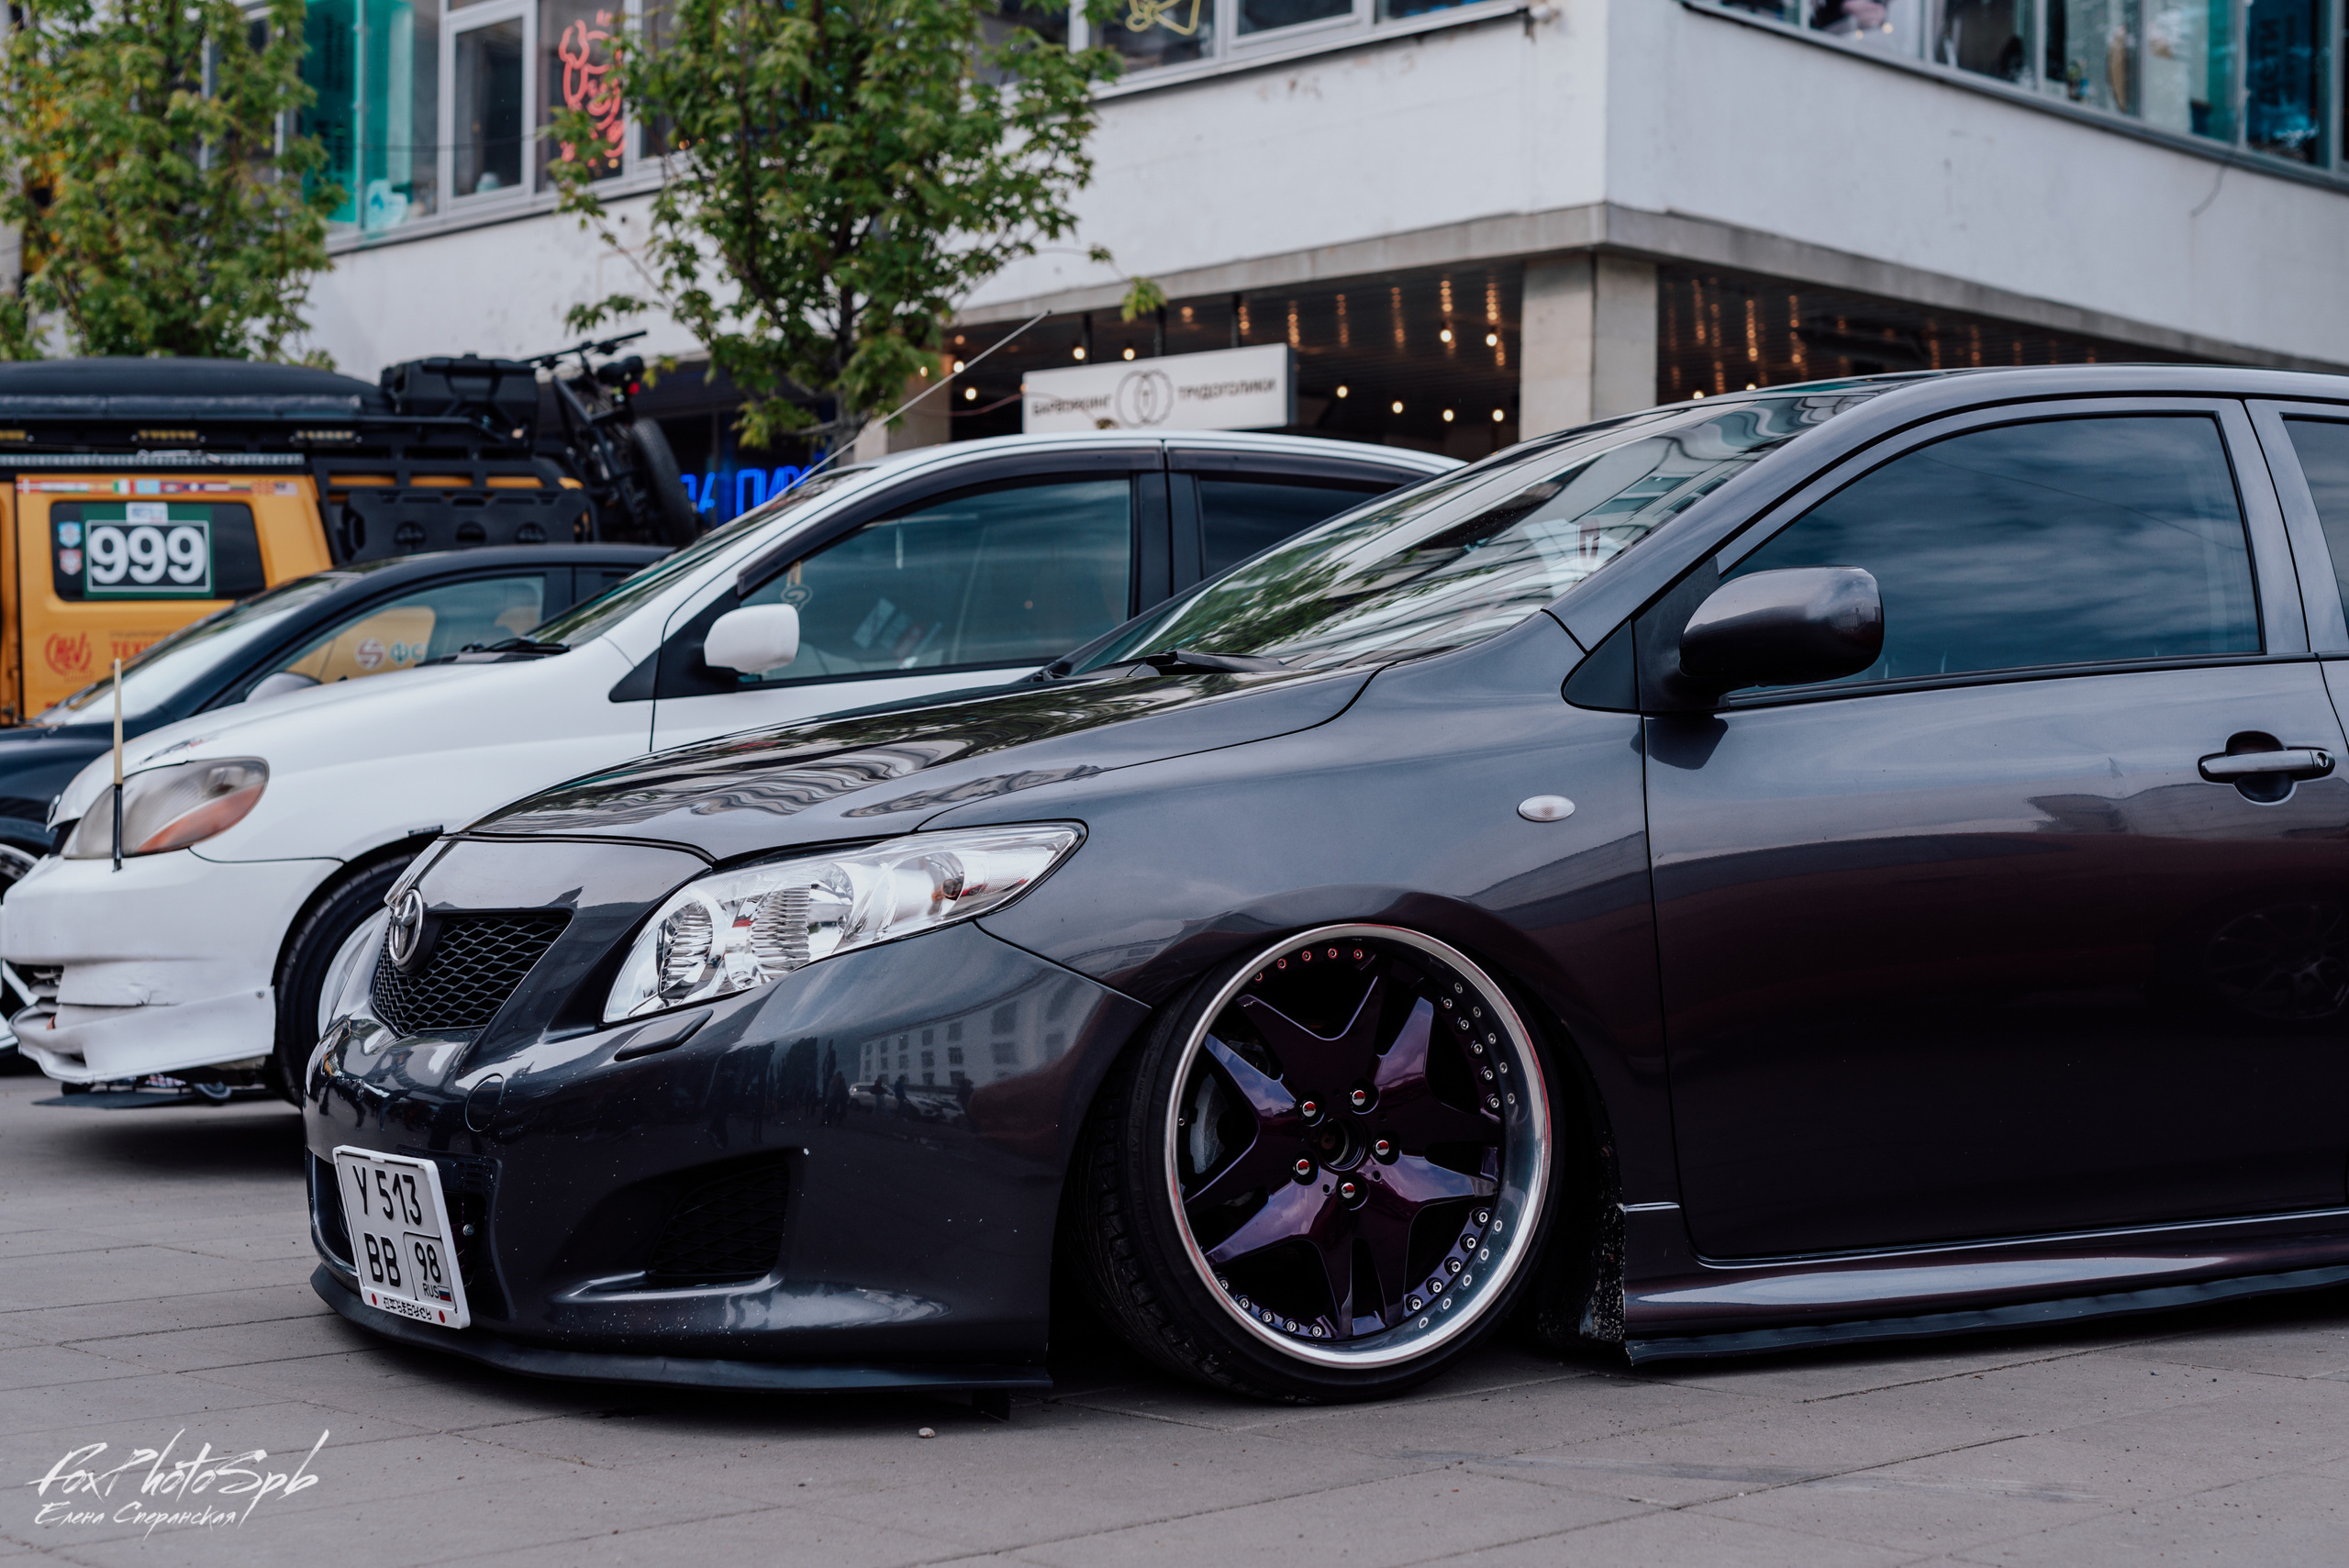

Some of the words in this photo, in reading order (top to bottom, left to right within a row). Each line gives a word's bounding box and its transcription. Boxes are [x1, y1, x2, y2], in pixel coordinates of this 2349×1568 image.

[88, 526, 207, 584] 999
[375, 1170, 422, 1226] 513
[415, 1241, 442, 1284] 98
[423, 1283, 440, 1297] RUS
